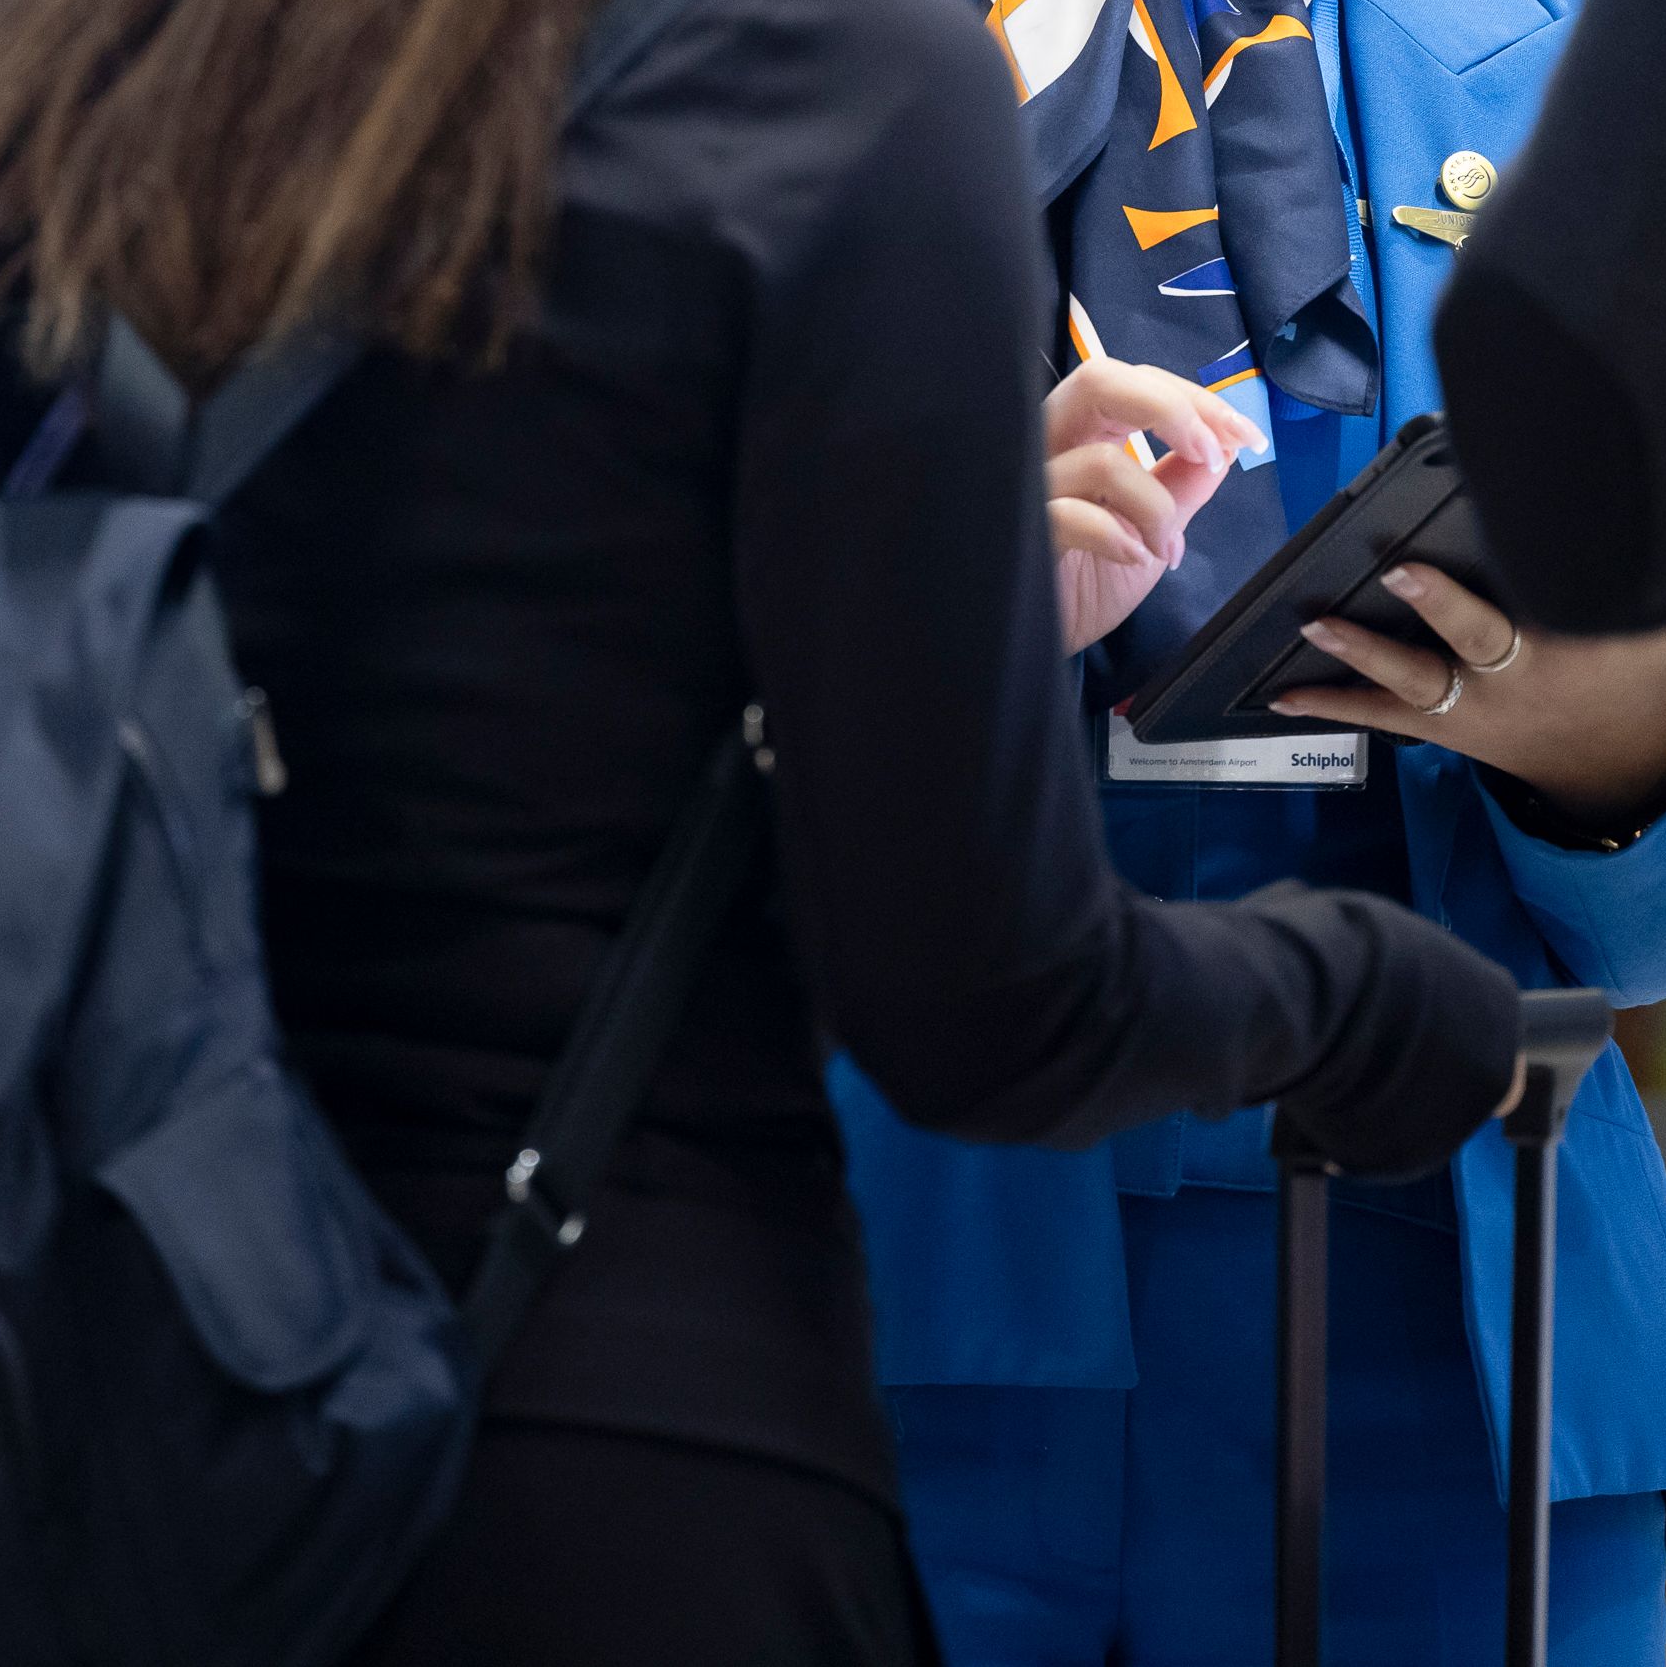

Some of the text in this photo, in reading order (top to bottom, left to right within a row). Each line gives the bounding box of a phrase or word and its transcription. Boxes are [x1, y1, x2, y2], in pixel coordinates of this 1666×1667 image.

[1448, 156, 1477, 192] SKYTEAM
[1129, 757, 1257, 767] Welcome to Amsterdam Airport
[1290, 753, 1355, 770] Schiphol
